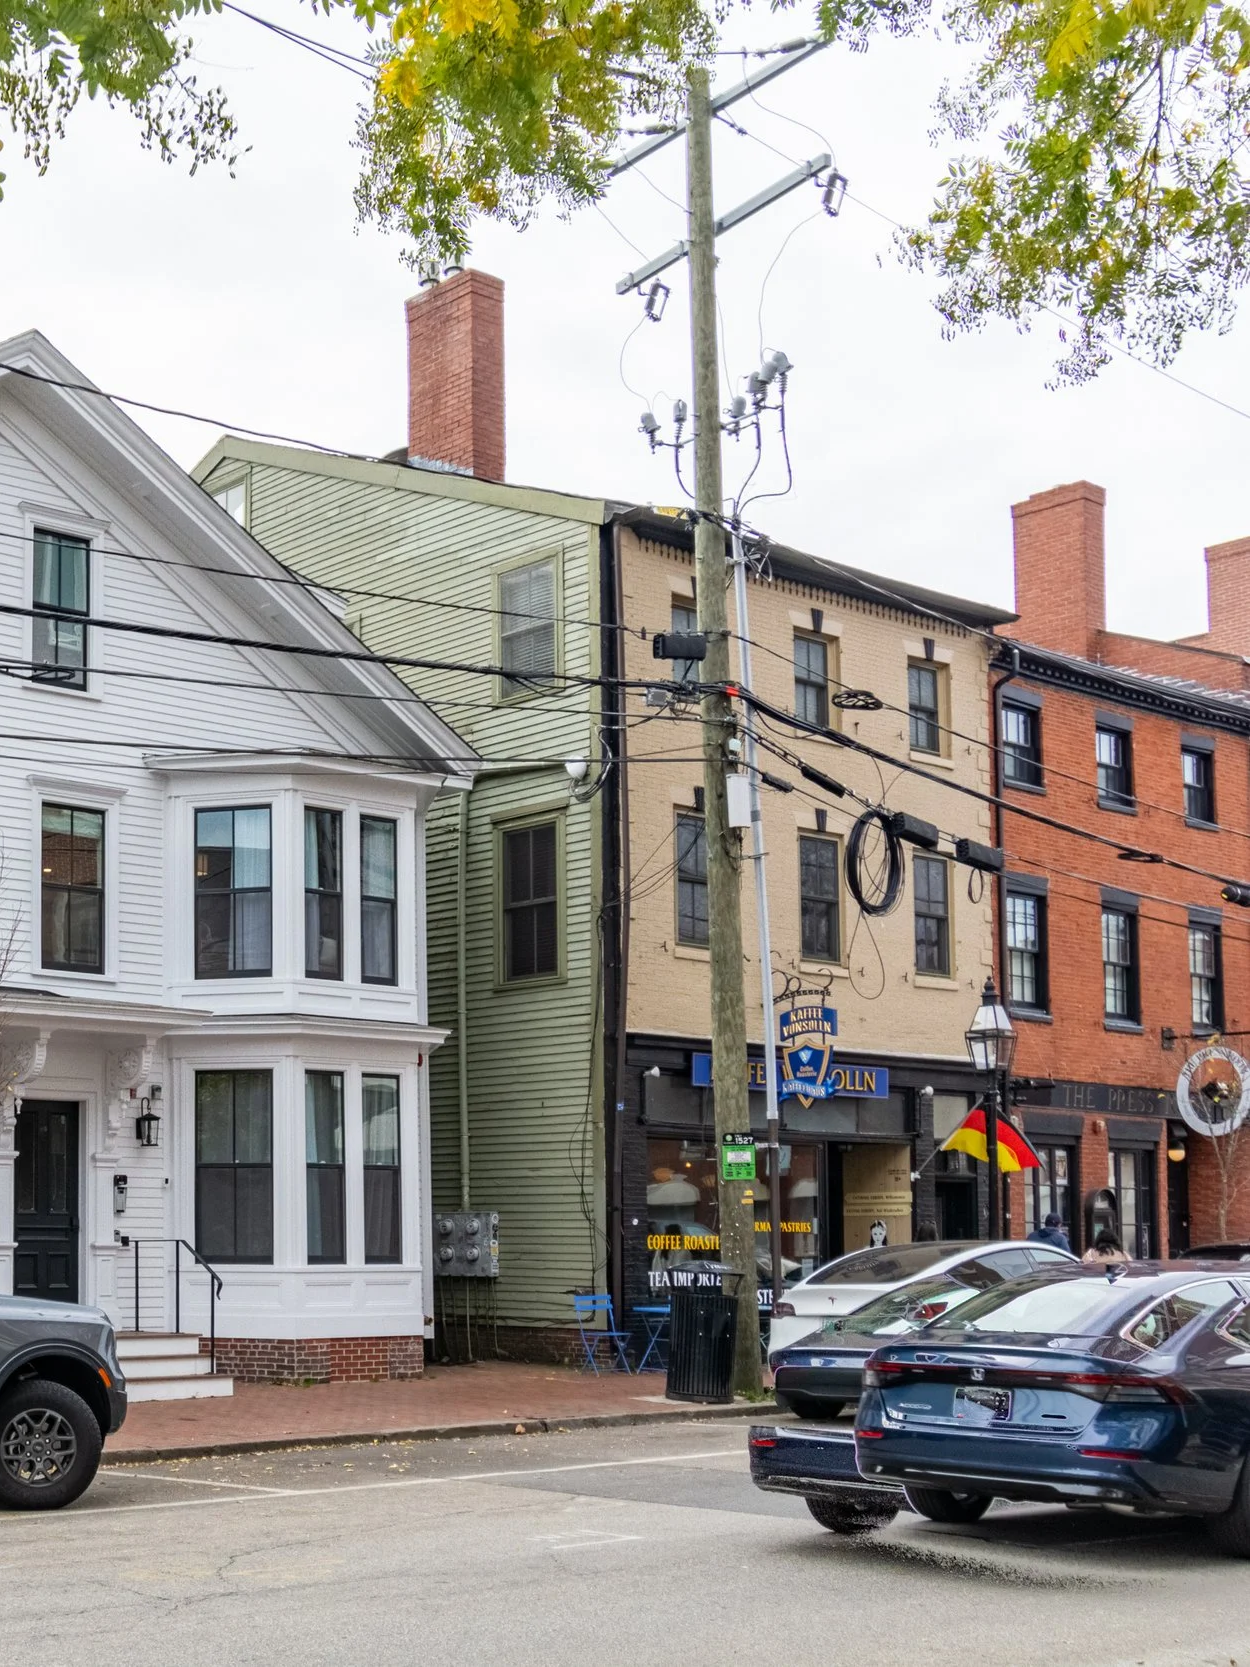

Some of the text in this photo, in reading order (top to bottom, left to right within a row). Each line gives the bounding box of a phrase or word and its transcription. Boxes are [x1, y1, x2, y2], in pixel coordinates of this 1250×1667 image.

[790, 1008, 823, 1022] KAFFEE
[782, 1020, 832, 1037] VONSOLLN
[832, 1068, 876, 1092] OLLN
[1062, 1084, 1096, 1109] THE
[1108, 1088, 1154, 1113] PRESS
[735, 1136, 754, 1145] 1527
[647, 1234, 681, 1251] COFFEE
[648, 1271, 670, 1287] TEA
